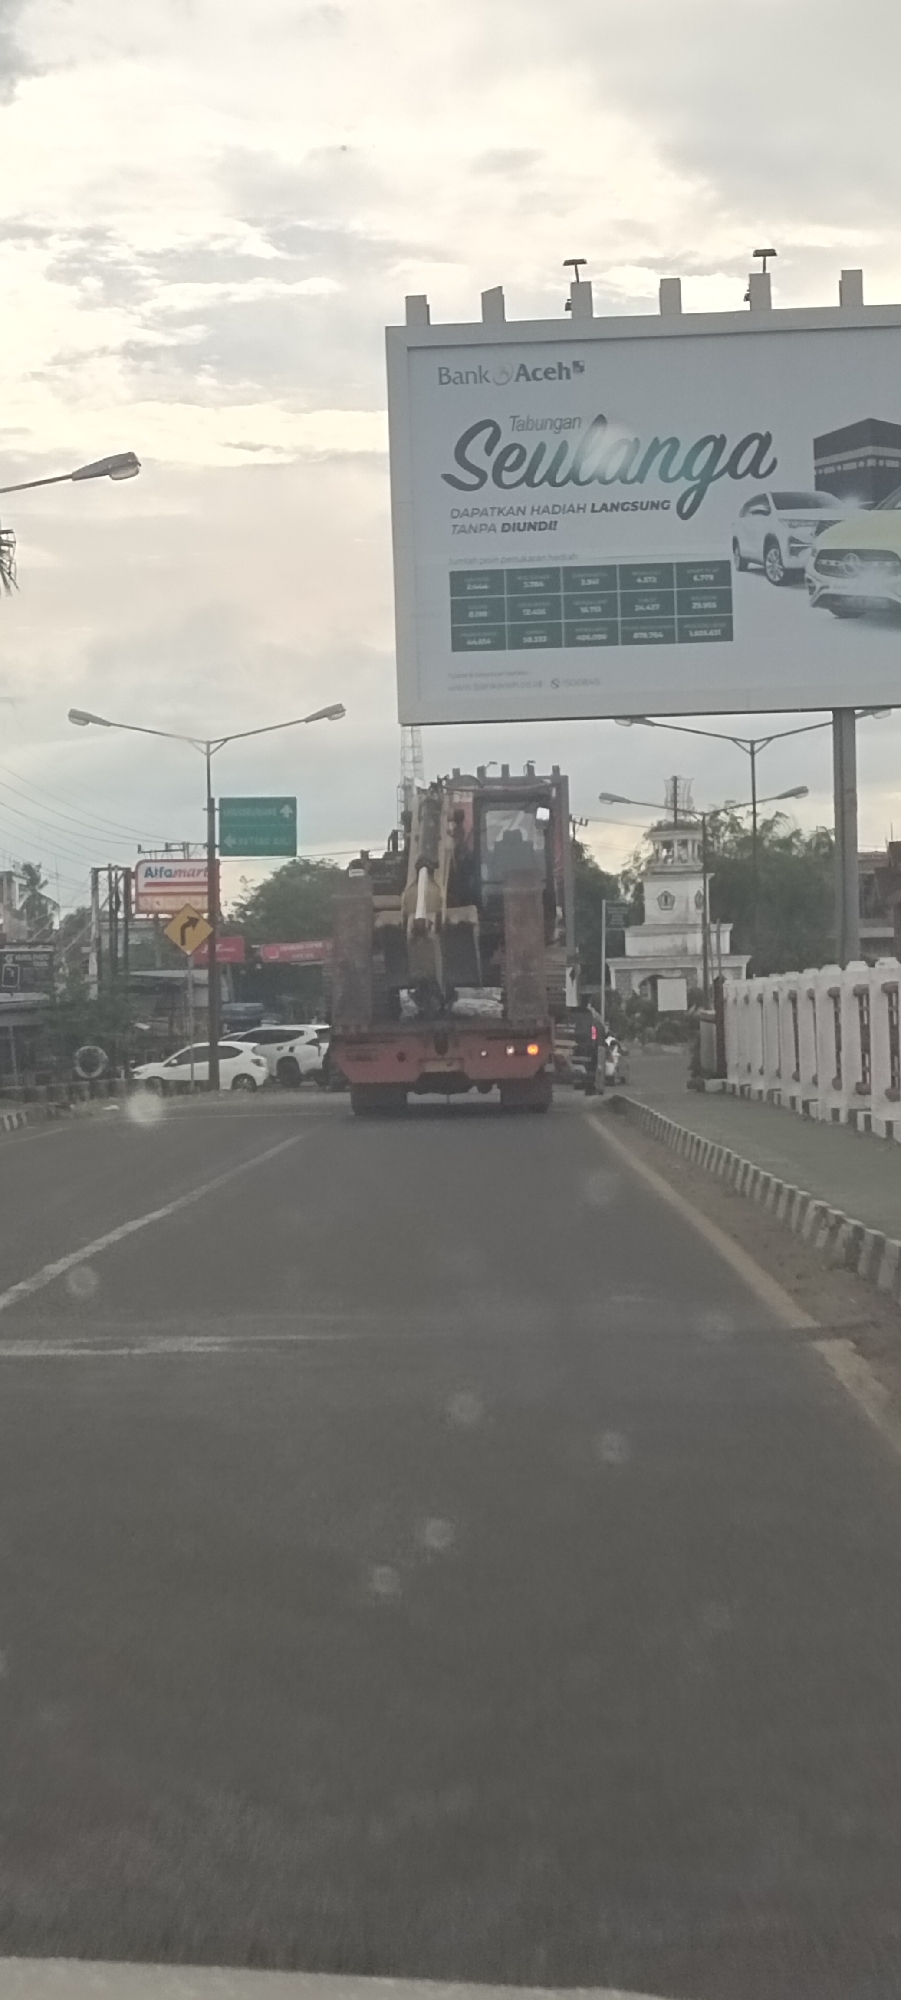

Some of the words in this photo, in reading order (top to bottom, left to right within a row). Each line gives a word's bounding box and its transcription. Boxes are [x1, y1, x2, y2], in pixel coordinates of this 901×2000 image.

[438, 365, 491, 386] Bank
[514, 361, 572, 383] Aceh
[509, 415, 582, 435] Tabungan
[440, 413, 778, 521] Seulanga
[450, 505, 527, 519] DAPATKAN
[530, 503, 587, 516] HADIAH
[590, 500, 671, 513] LANGSUNG
[451, 523, 497, 535] TANPA
[500, 520, 558, 533] DIUNDI!
